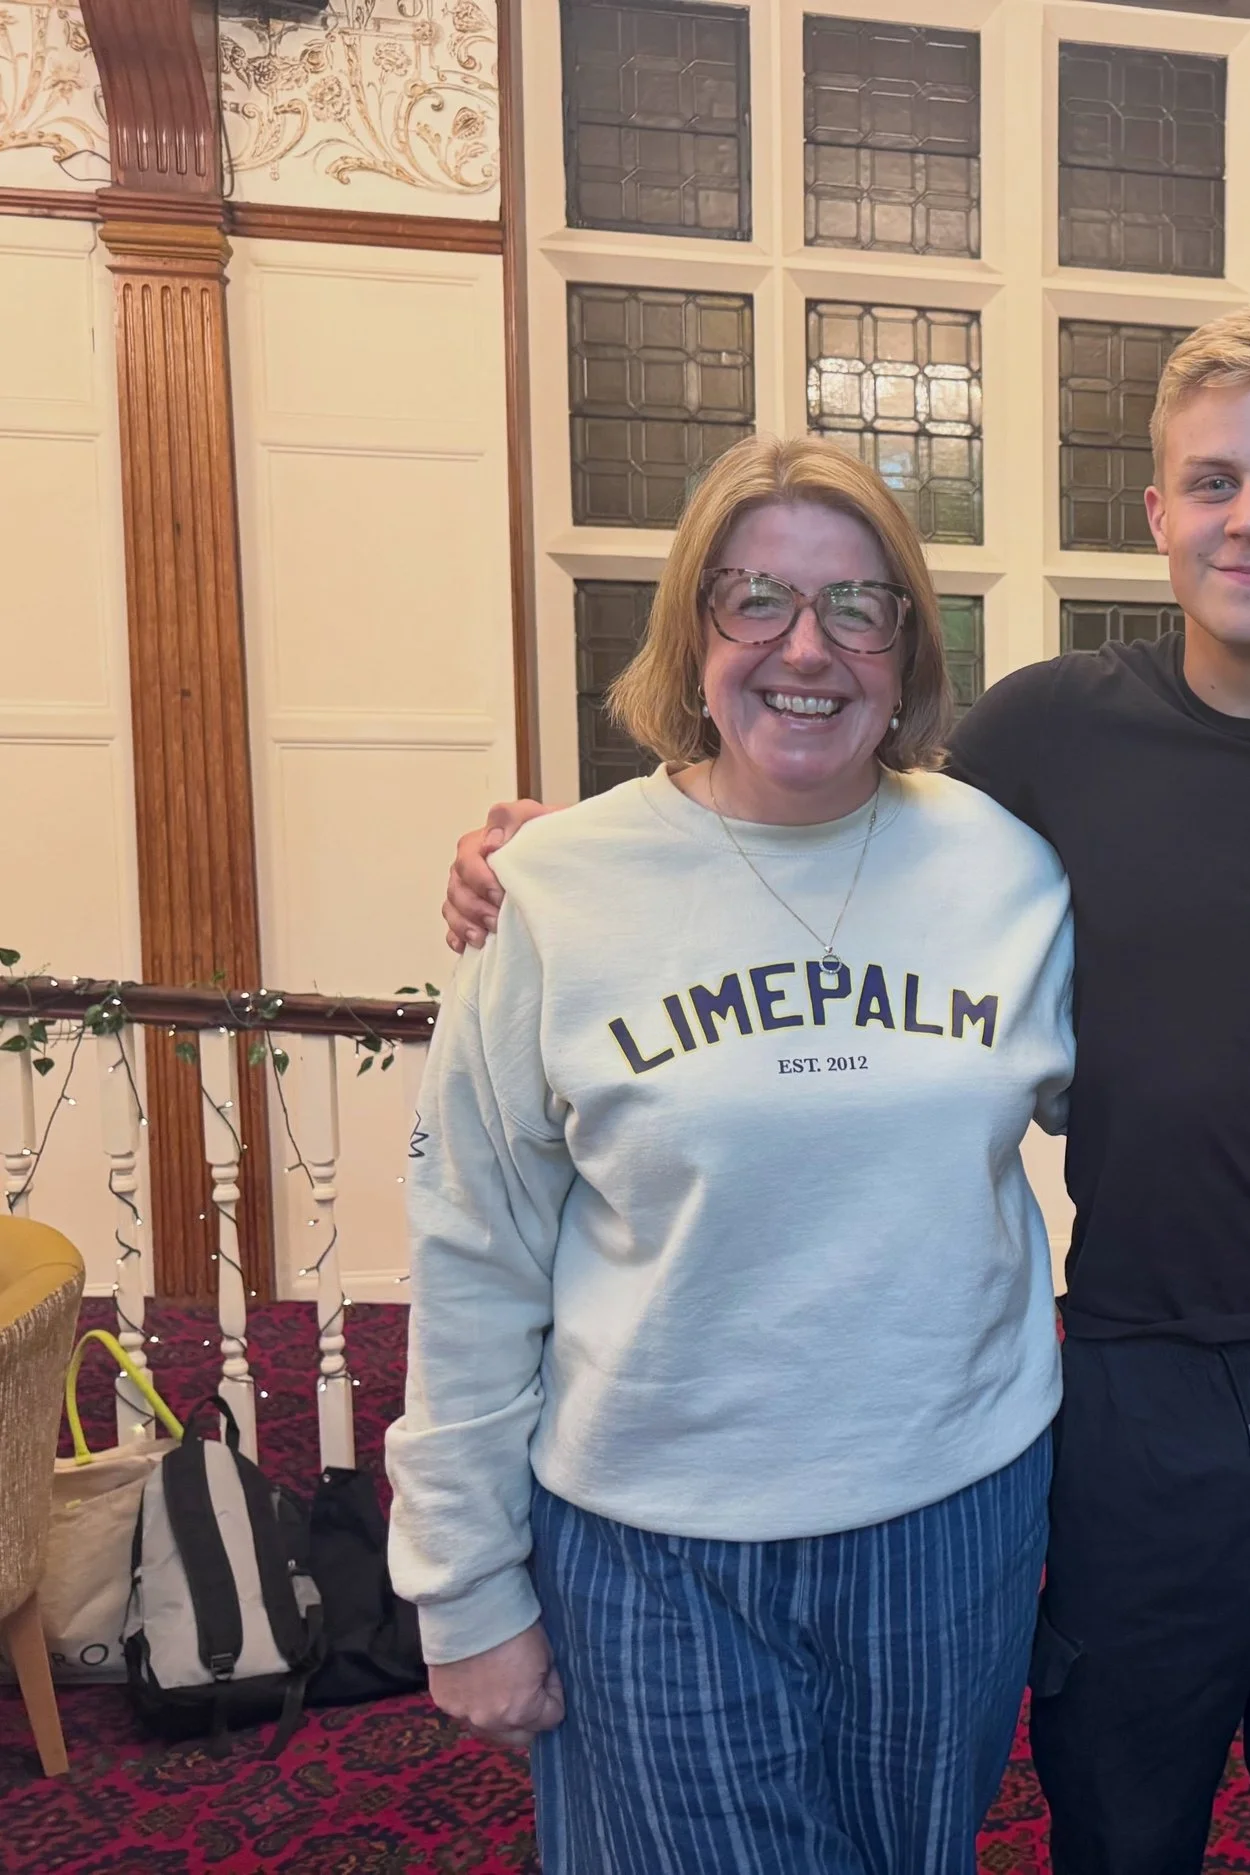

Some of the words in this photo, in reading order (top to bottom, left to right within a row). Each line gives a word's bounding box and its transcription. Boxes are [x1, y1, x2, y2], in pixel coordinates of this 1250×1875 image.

[607, 959, 1000, 1075] LIMEPALM
[777, 1058, 821, 1074] EST.
[826, 1055, 868, 1071] 2012
